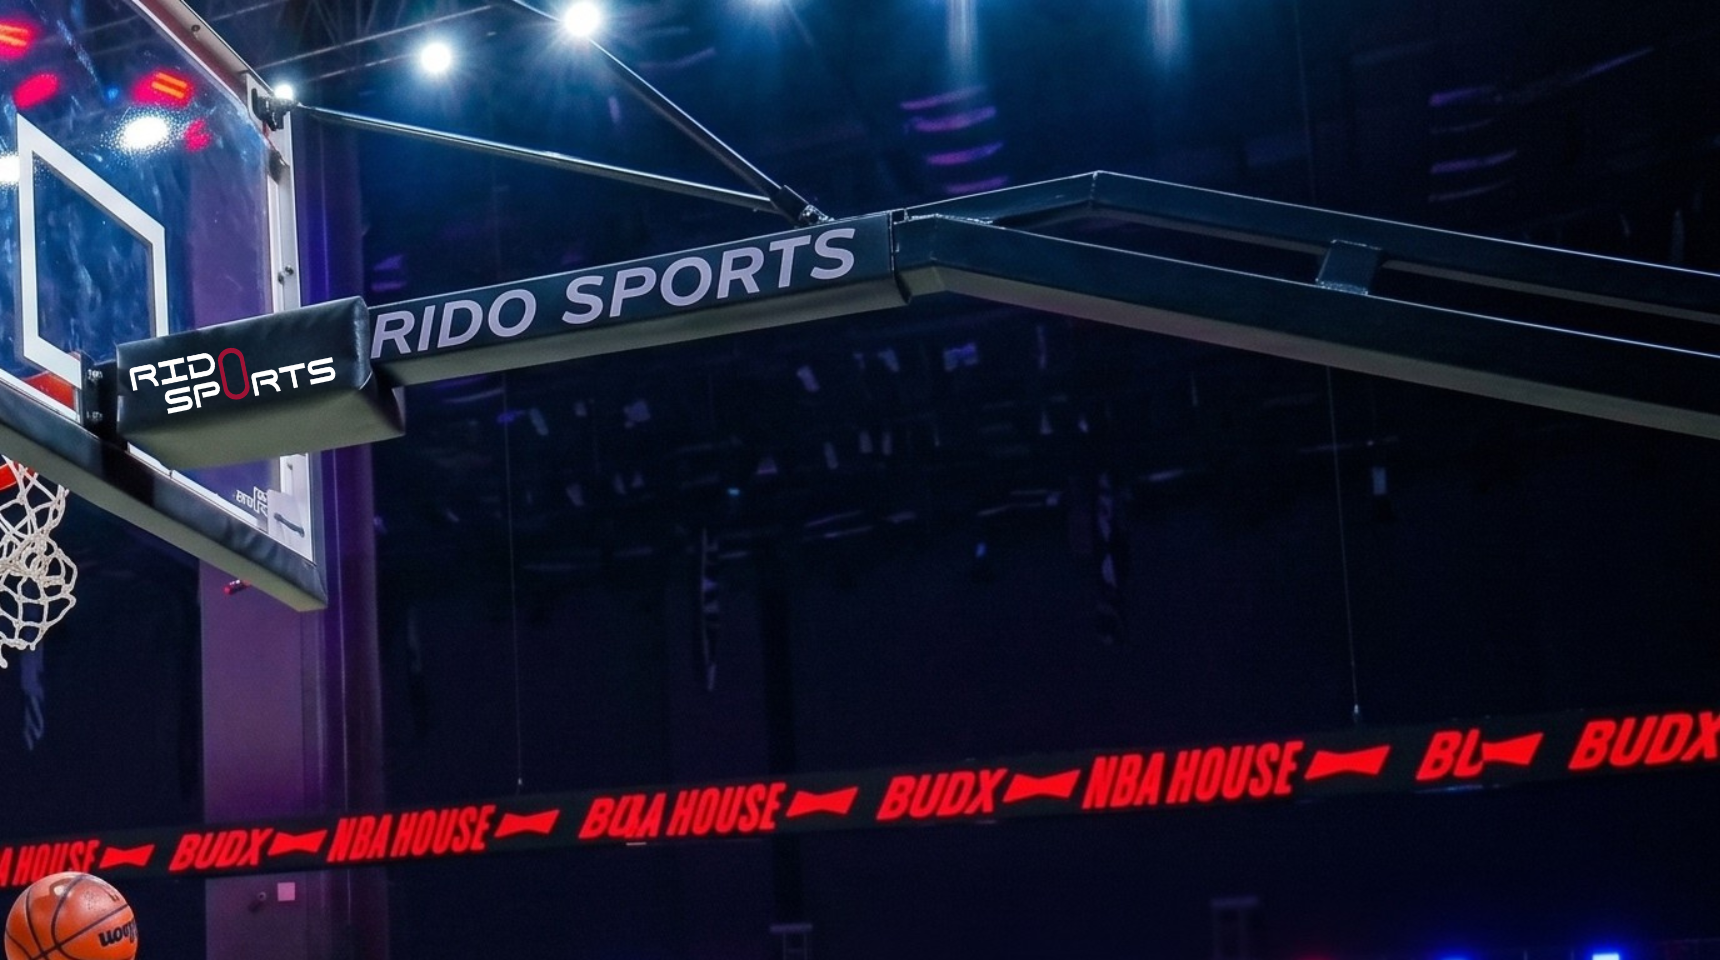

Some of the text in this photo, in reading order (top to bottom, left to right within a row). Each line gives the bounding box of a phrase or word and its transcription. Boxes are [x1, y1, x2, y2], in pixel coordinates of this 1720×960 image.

[370, 228, 856, 359] RIDO SPORTS
[164, 348, 336, 414] SPORTS
[1567, 711, 1720, 770] BUDX
[876, 768, 1008, 820] BUDX
[1081, 740, 1304, 810] NBA HOUSE
[327, 805, 497, 863] NBA HOUSE
[665, 782, 787, 836] HOUSE
[11, 839, 100, 886] HOUSE
[169, 828, 274, 872] BUDX
